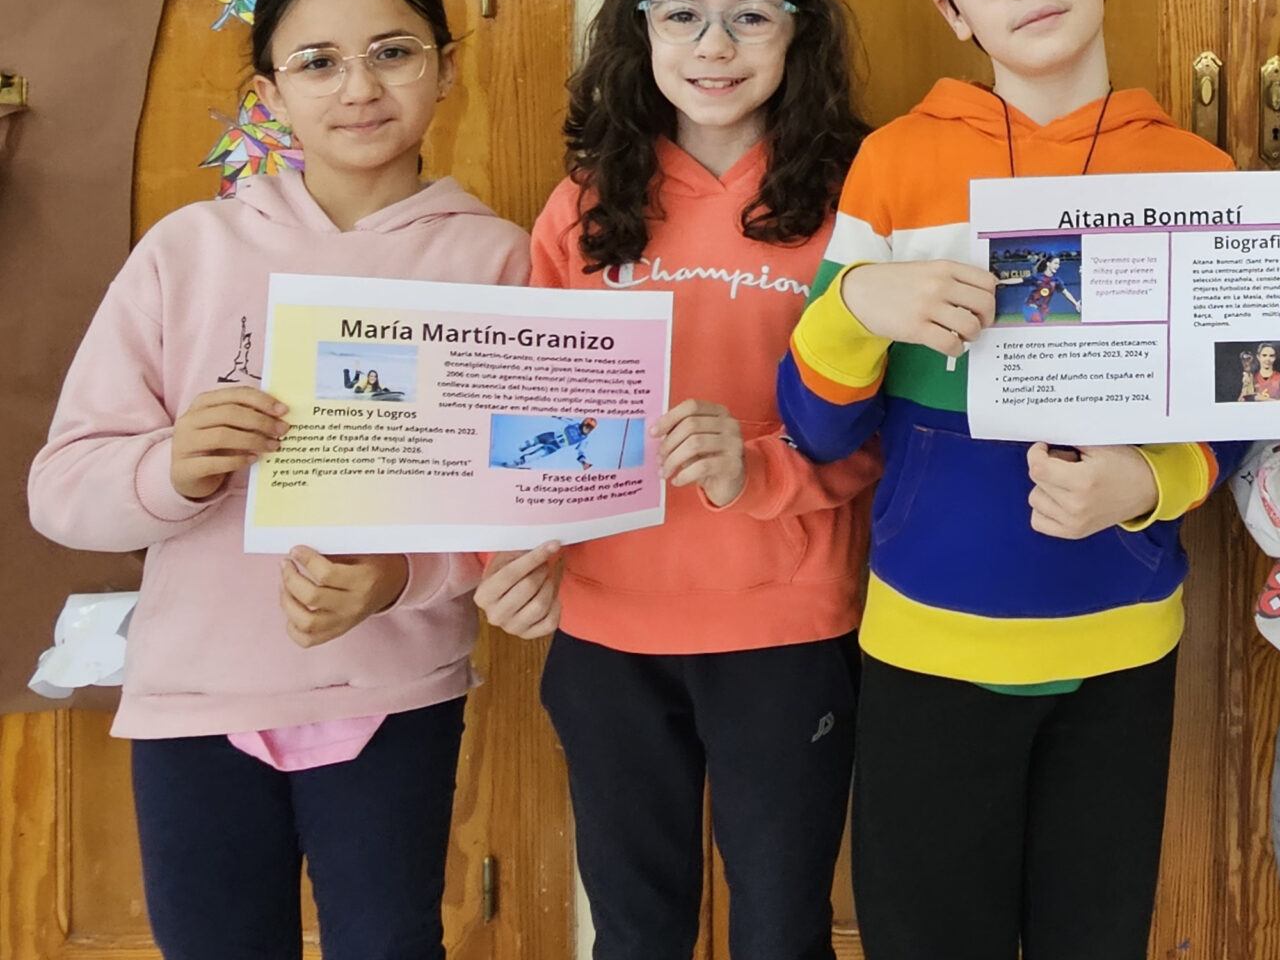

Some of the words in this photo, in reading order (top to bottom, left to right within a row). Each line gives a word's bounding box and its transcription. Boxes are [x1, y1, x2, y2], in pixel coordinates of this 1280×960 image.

[1058, 209, 1134, 228] Aitana
[1144, 205, 1243, 226] Bonmatí
[603, 256, 810, 300] Champion
[341, 319, 413, 341] María
[422, 323, 615, 350] Martín-Granizo
[1078, 340, 1109, 348] premios
[1027, 352, 1037, 360] de
[1002, 375, 1044, 383] Campeona
[1045, 373, 1058, 381] del
[1060, 373, 1088, 381] Mundo
[1106, 371, 1133, 381] España
[1146, 371, 1154, 379] el
[1002, 385, 1035, 393] Mundial
[1002, 397, 1026, 406] Mejor
[1075, 394, 1103, 403] Europa
[312, 406, 363, 417] Premios
[367, 410, 374, 420] y
[377, 408, 417, 420] Logros
[404, 426, 444, 434] adaptado
[340, 434, 369, 442] España
[432, 458, 440, 466] in
[312, 468, 338, 476] figura
[542, 474, 572, 482] Frase
[575, 473, 617, 482] célebre
[533, 484, 595, 494] discapacidad
[613, 479, 643, 489] define
[515, 496, 524, 504] lo
[526, 498, 544, 506] que
[548, 497, 564, 506] soy
[566, 496, 594, 504] capaz
[597, 493, 608, 501] de
